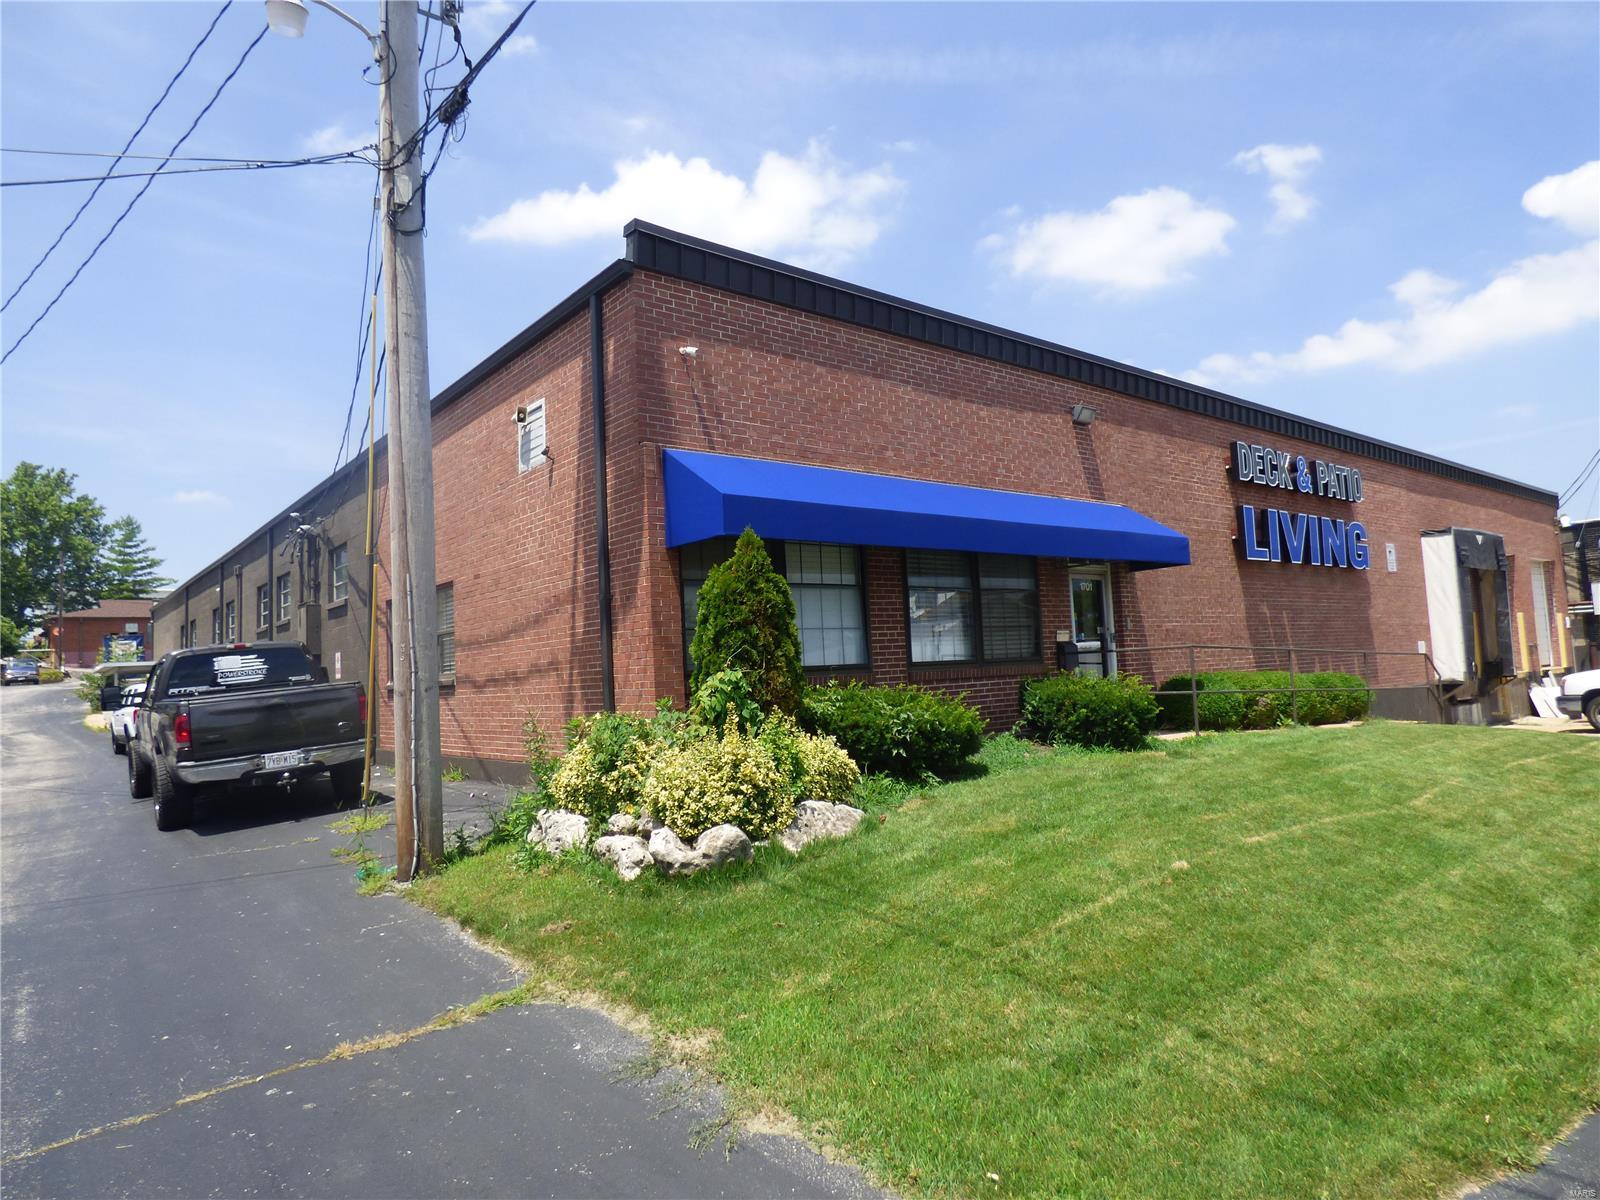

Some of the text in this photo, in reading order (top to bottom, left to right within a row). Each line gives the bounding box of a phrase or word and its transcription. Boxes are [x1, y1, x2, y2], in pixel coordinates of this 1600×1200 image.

[1236, 441, 1364, 503] DECK & PATIO
[1243, 505, 1370, 569] LIVING
[1080, 582, 1093, 592] 1701
